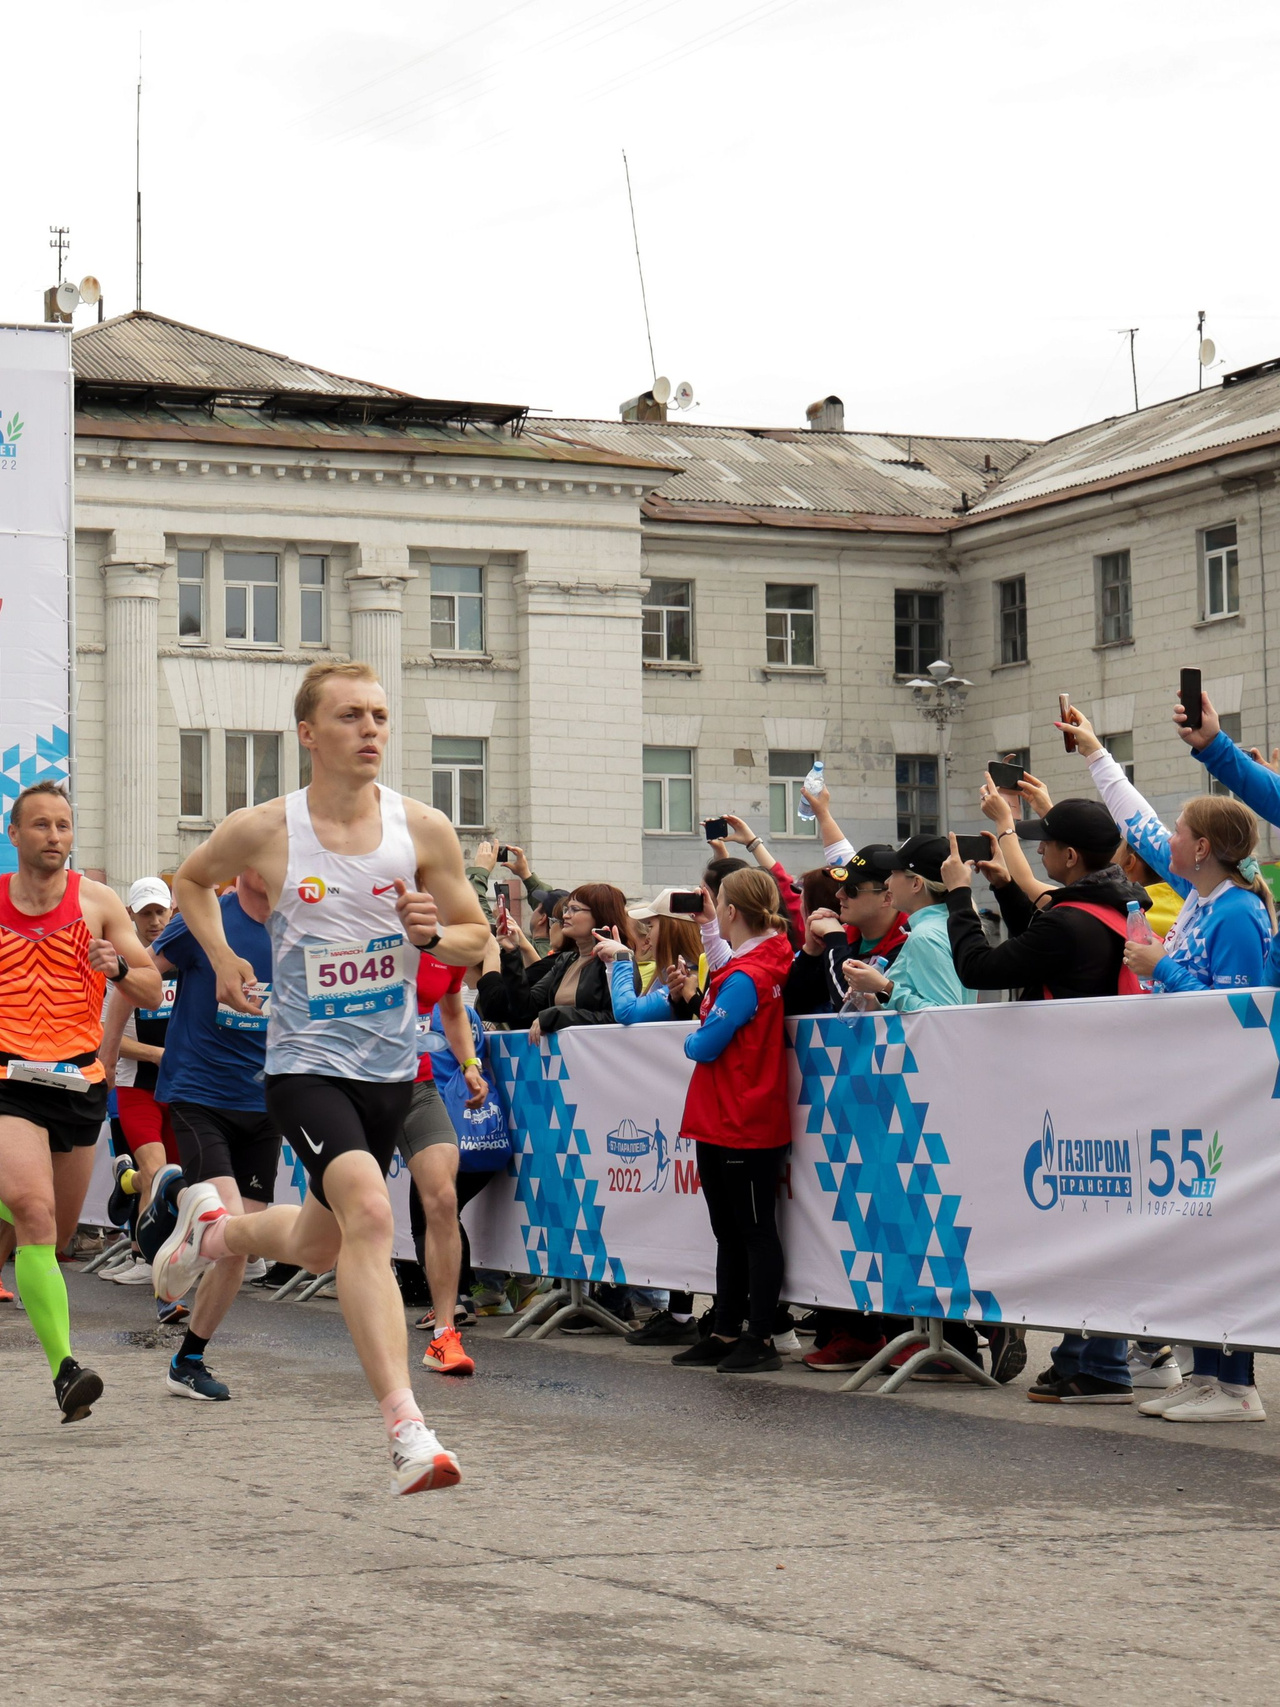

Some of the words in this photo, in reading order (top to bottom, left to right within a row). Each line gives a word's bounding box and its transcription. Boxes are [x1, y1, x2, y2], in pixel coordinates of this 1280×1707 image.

[851, 855, 867, 867] СР
[319, 954, 395, 988] 5048
[1234, 974, 1248, 985] 55
[63, 1065, 72, 1073] 10
[460, 1138, 510, 1150] МАРАФОН
[1057, 1139, 1131, 1173] ГАЗПРОМ
[1148, 1128, 1206, 1197] 55
[607, 1168, 641, 1192] 2022
[1061, 1178, 1131, 1194] ТРАНСГАЗ
[1191, 1180, 1215, 1196] ЛЕТ
[1147, 1201, 1213, 1217] 1967-2022
